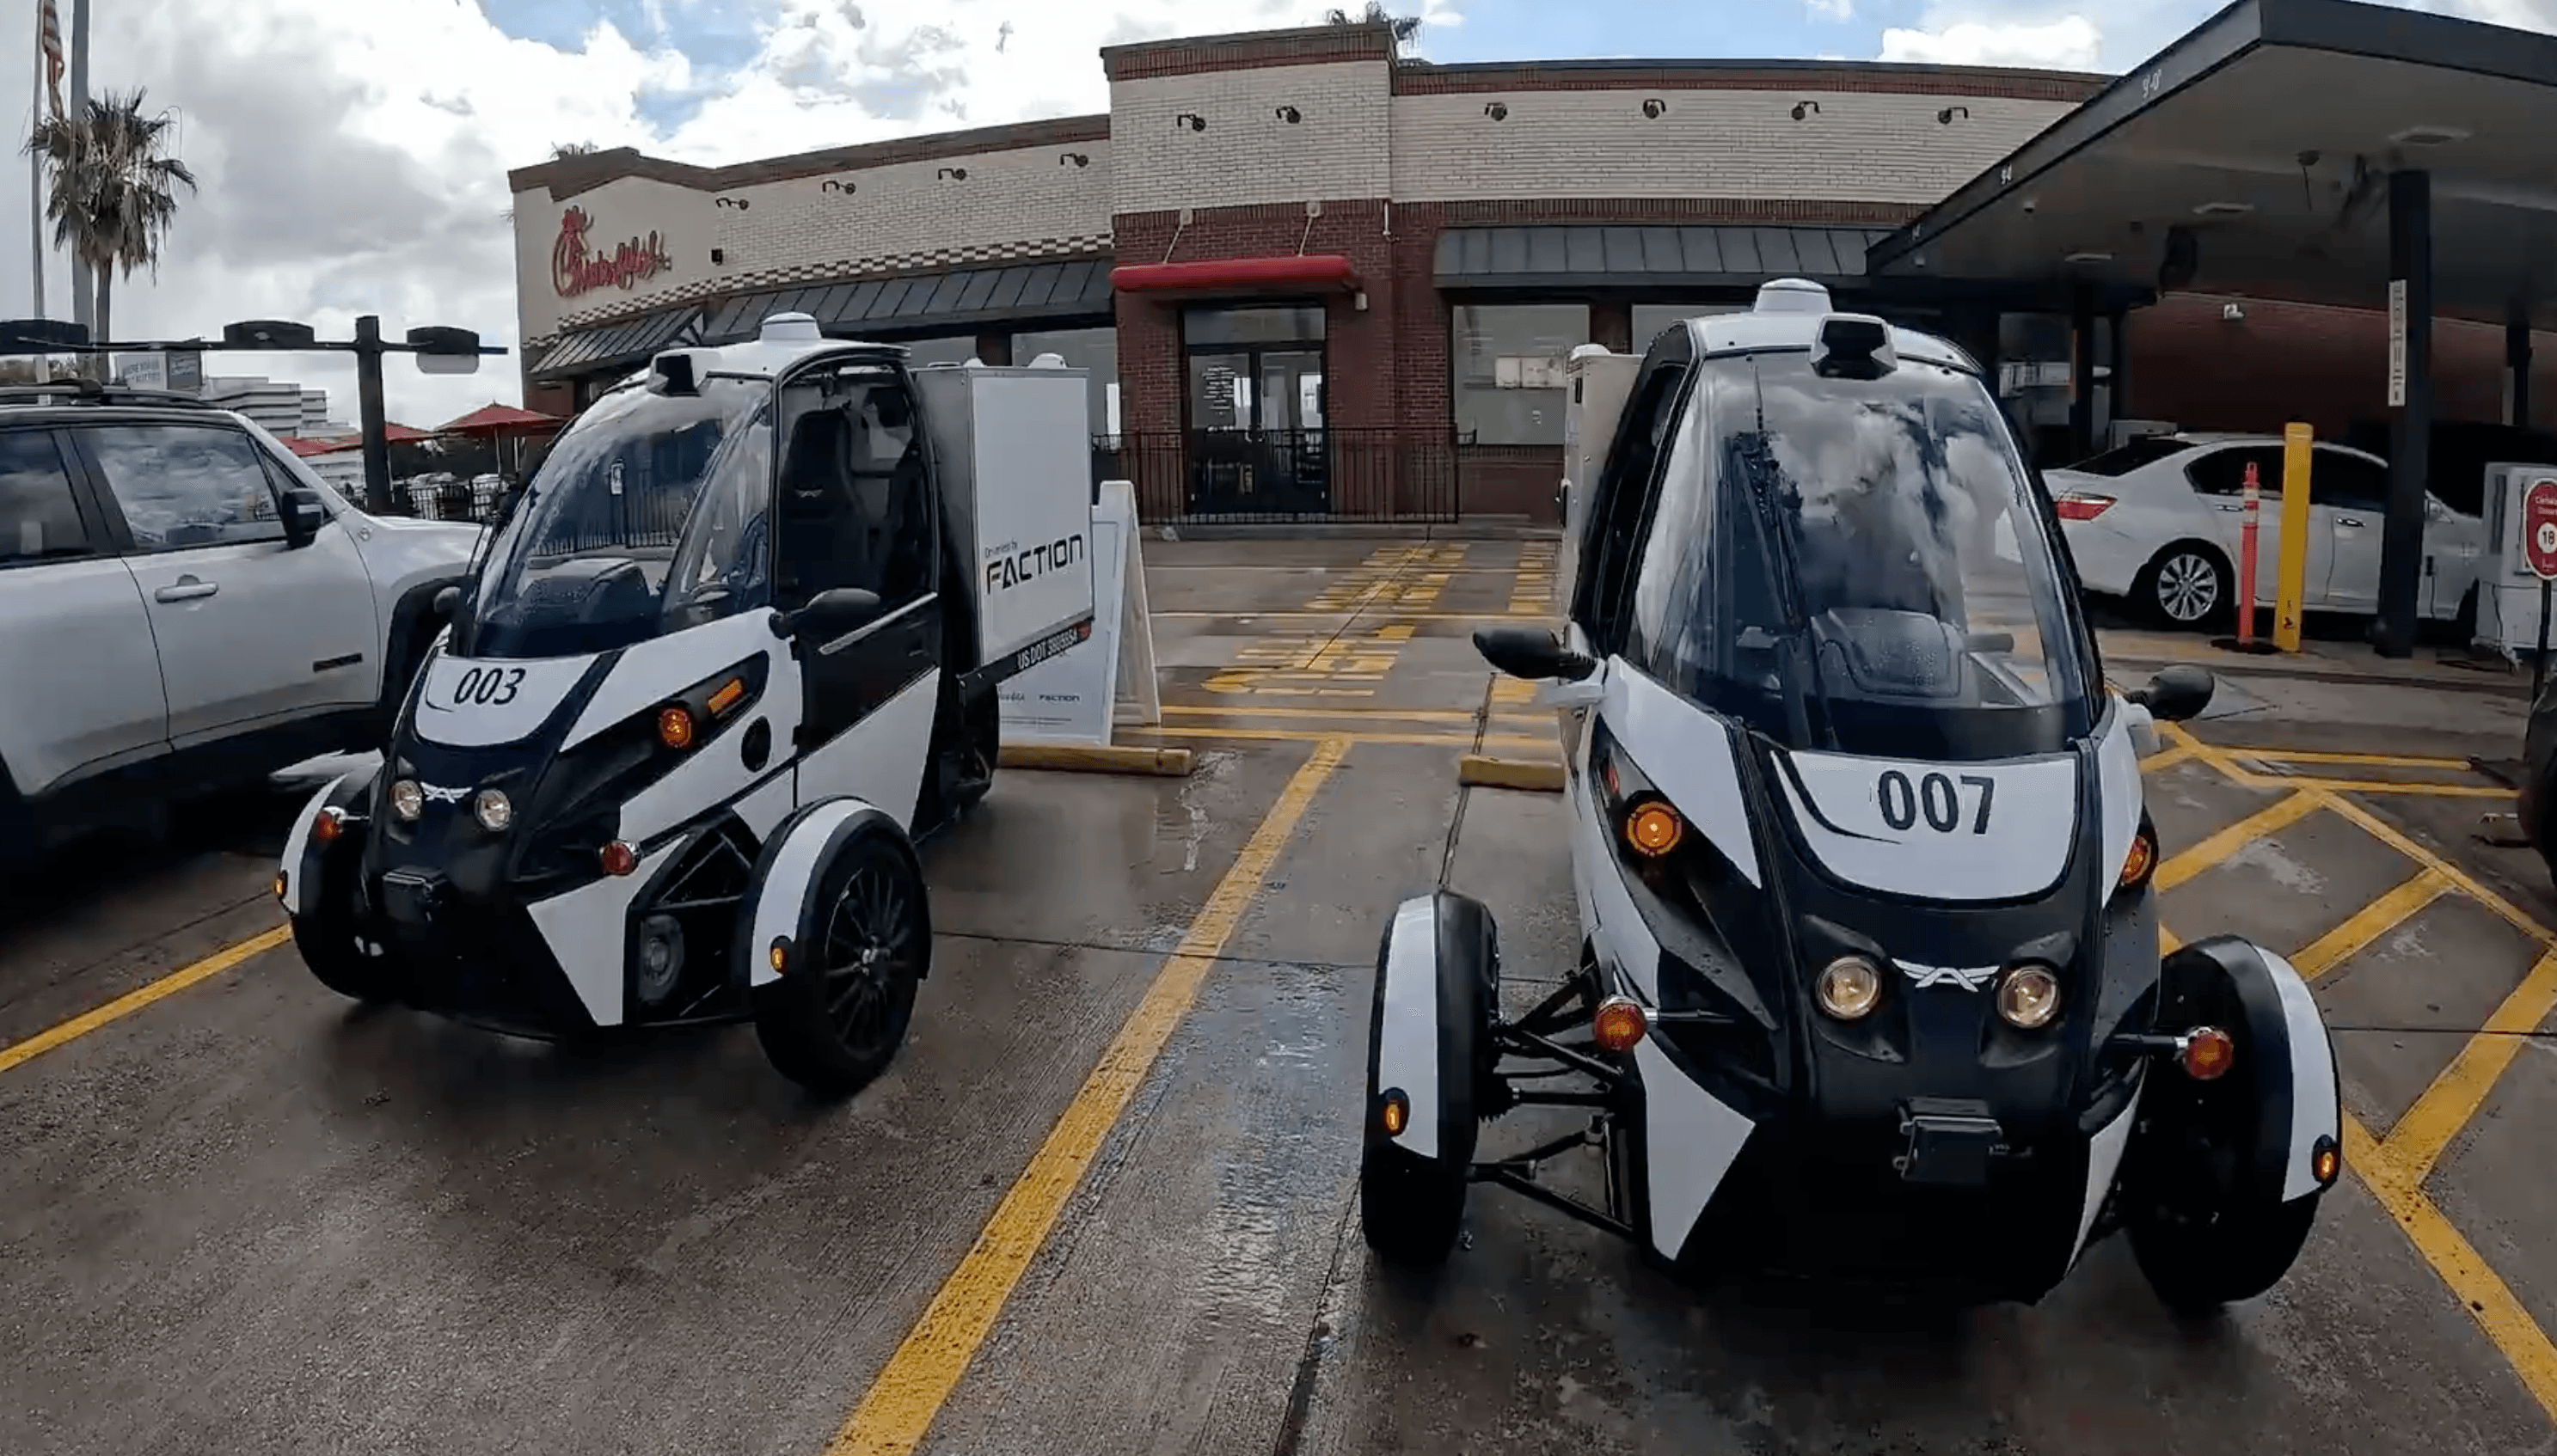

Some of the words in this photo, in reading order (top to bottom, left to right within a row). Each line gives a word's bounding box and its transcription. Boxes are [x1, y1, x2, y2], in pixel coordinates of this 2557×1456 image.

[2542, 530, 2555, 545] 18
[986, 534, 1083, 595] FACTION
[1017, 650, 1030, 670] US
[1030, 641, 1046, 664] DOT
[454, 667, 526, 706] 003
[1878, 770, 1995, 835] 007
